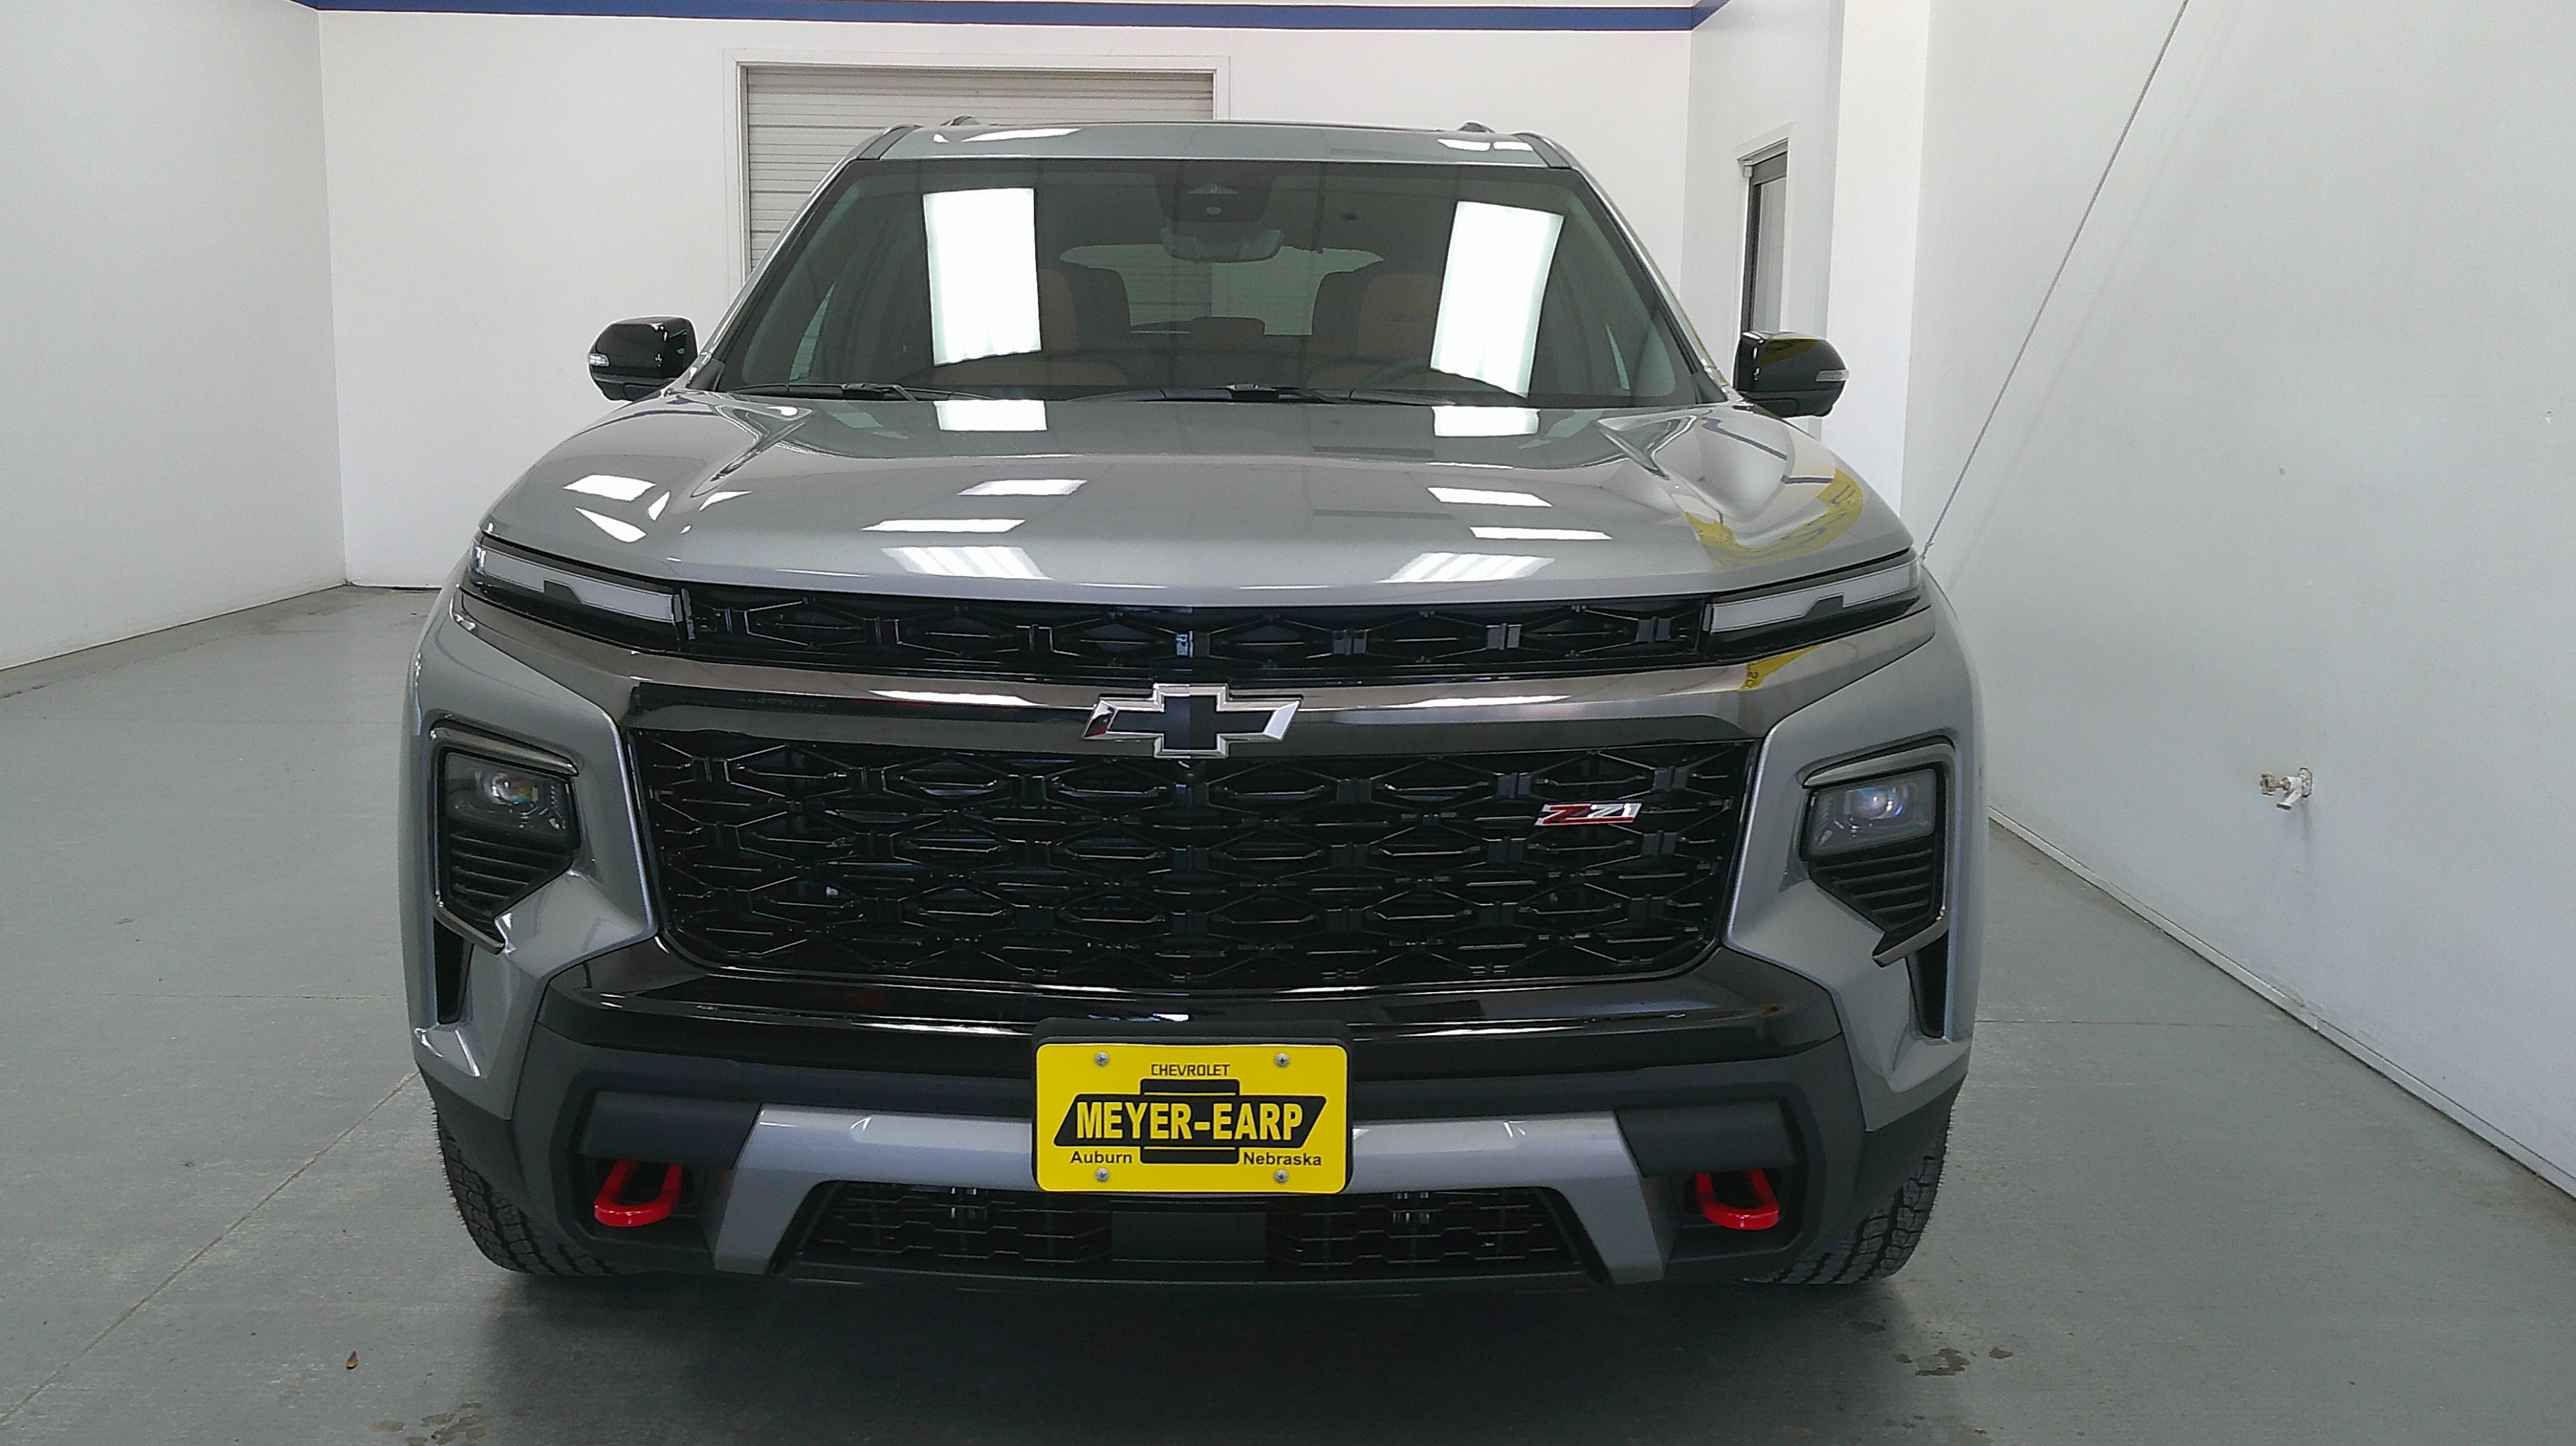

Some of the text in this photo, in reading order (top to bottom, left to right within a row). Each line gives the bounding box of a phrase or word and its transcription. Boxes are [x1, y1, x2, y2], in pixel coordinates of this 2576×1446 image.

[1534, 803, 1643, 826] Z71
[1150, 1063, 1231, 1077] CHEVROLET
[1075, 1101, 1304, 1141] MEYER-EARP
[1070, 1150, 1322, 1166] Auburn Nebraska
